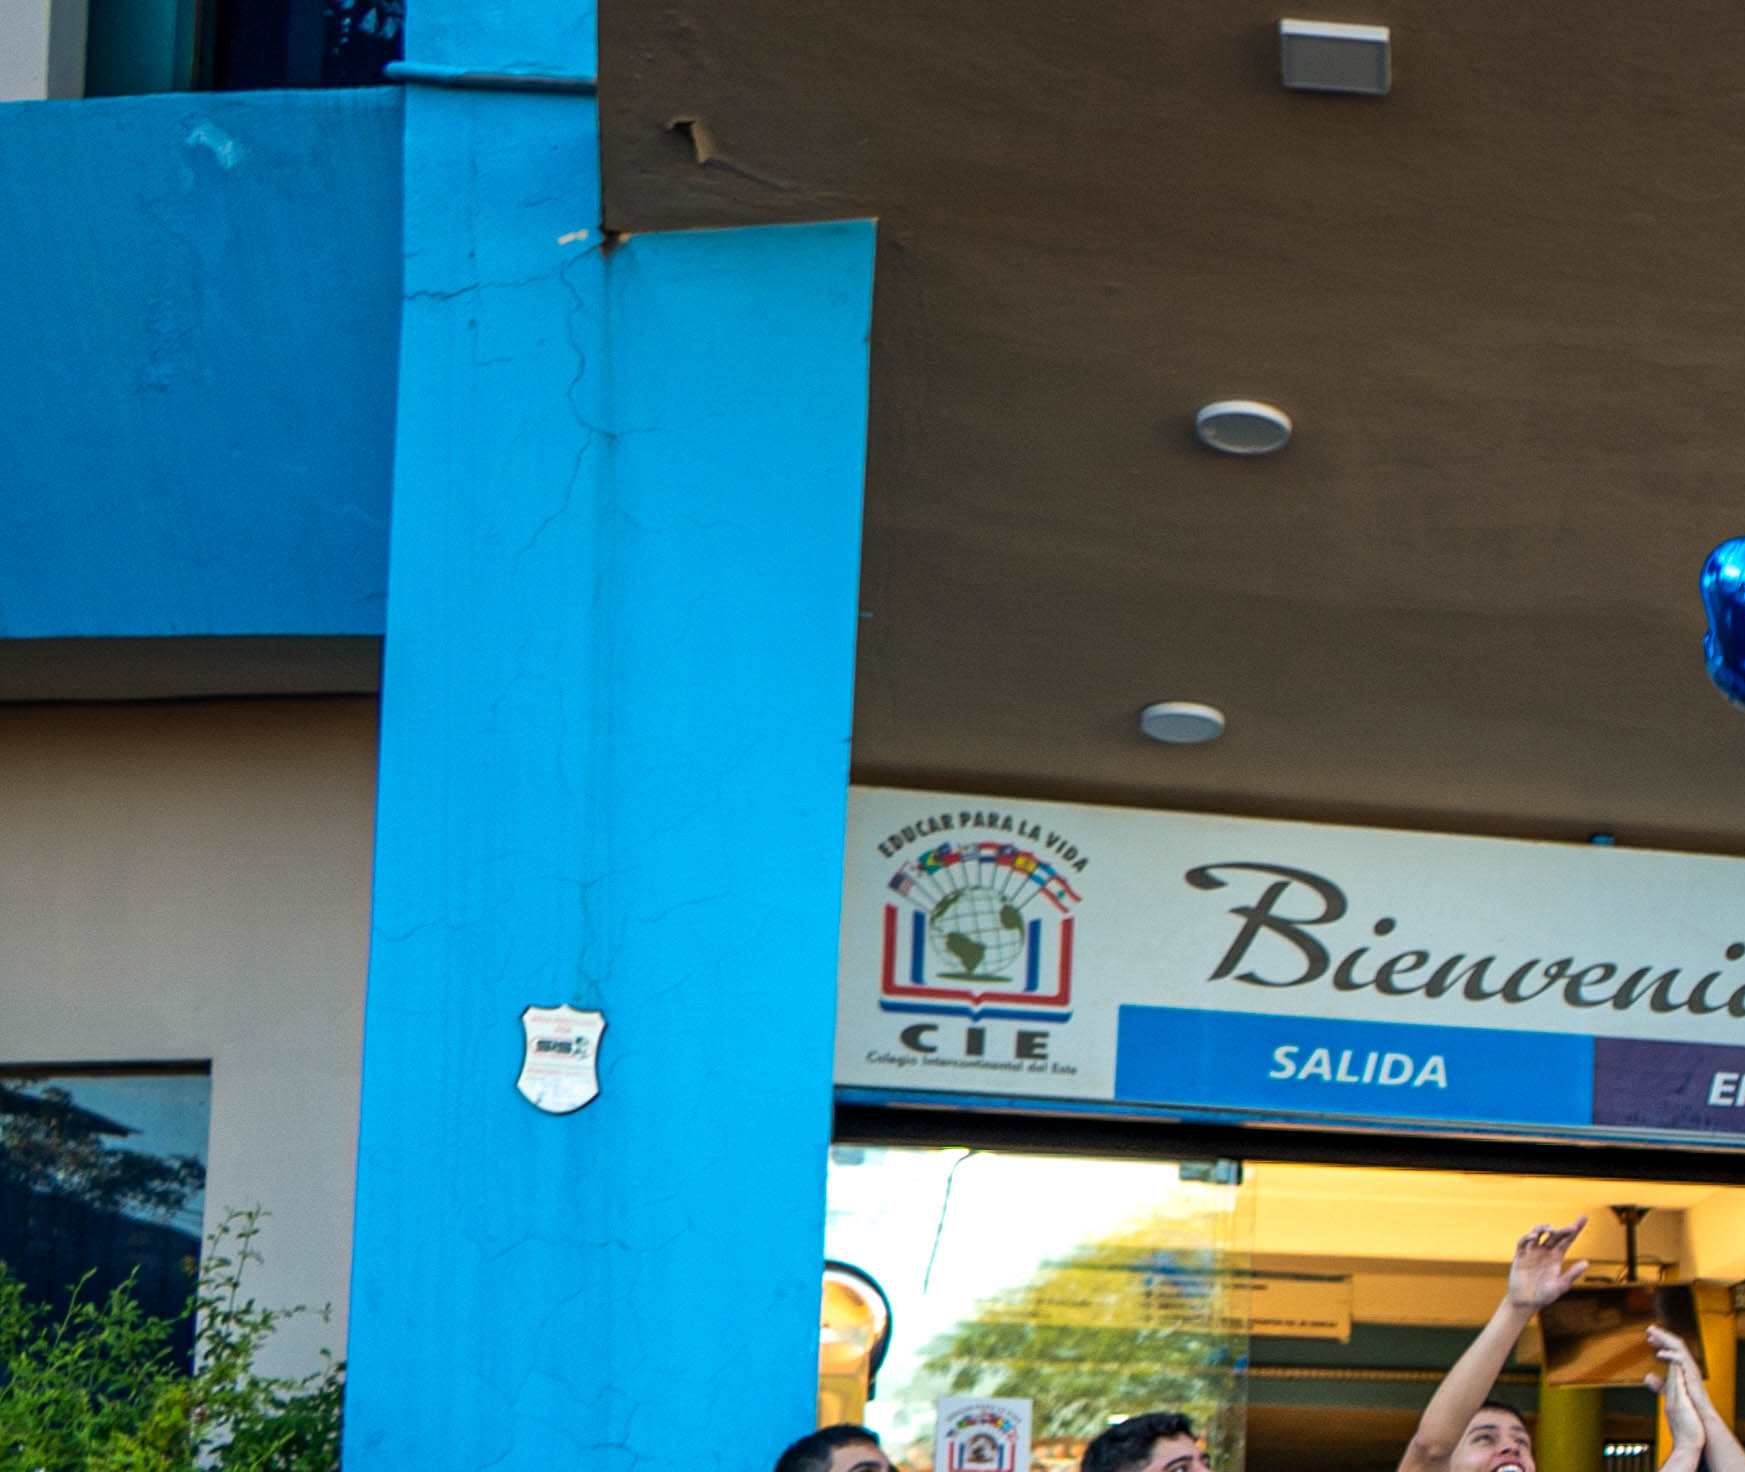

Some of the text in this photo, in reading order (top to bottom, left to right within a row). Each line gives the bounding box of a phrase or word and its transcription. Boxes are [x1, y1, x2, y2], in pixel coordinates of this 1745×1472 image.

[877, 811, 1089, 873] EDUCAR PARA LA VIDA
[900, 1024, 1049, 1060] CIE
[866, 1051, 1077, 1075] Colegio Intercontinental del Este
[1269, 1045, 1449, 1090] SALIDA
